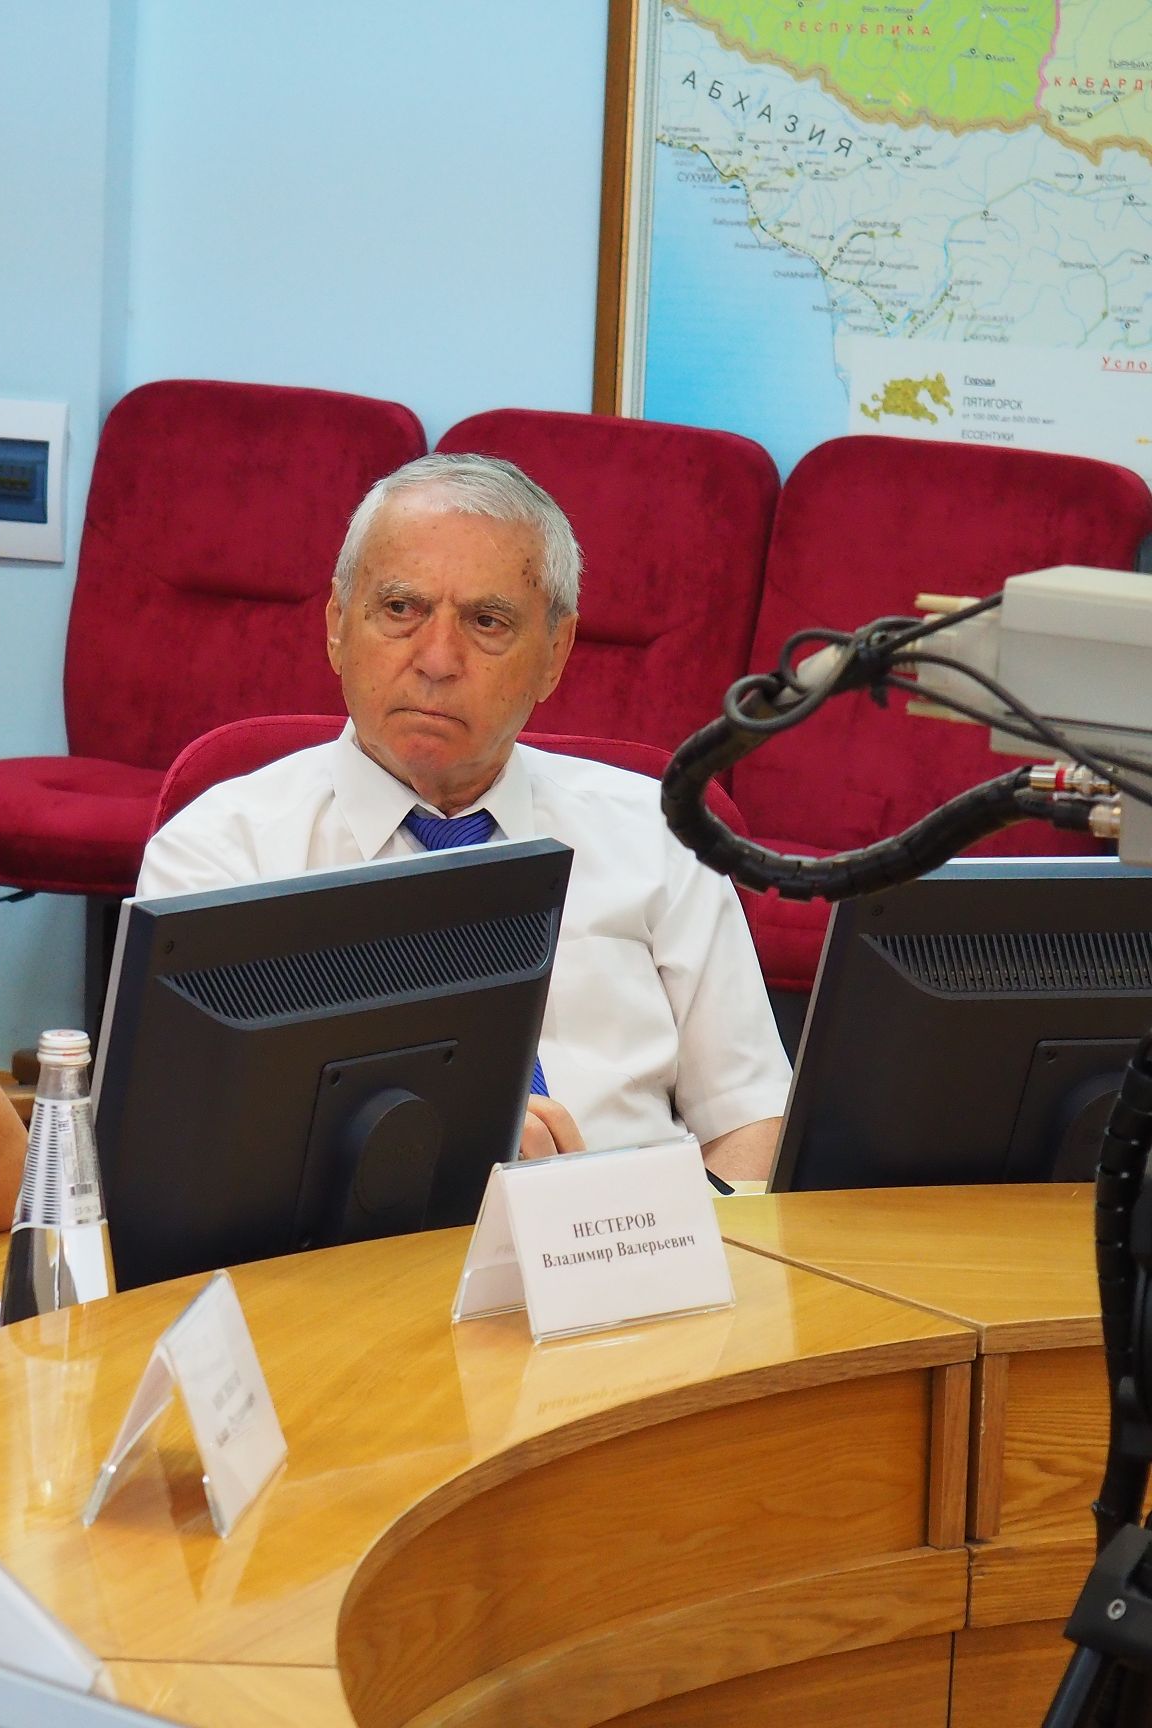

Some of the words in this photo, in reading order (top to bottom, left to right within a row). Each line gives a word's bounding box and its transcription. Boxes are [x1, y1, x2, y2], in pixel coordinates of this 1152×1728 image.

[784, 20, 932, 36] РЕСПУБЛИКА
[1054, 76, 1152, 91] КАБАРД
[682, 70, 853, 157] АБХАЗИЯ
[962, 396, 1024, 410] ПЯТИГОРСК
[961, 429, 1015, 441] ЕССЕНТУКИ
[572, 1212, 656, 1238] НЕСТЕРОВ
[542, 1246, 613, 1268] Владимир
[616, 1233, 695, 1257] Валерьевич
